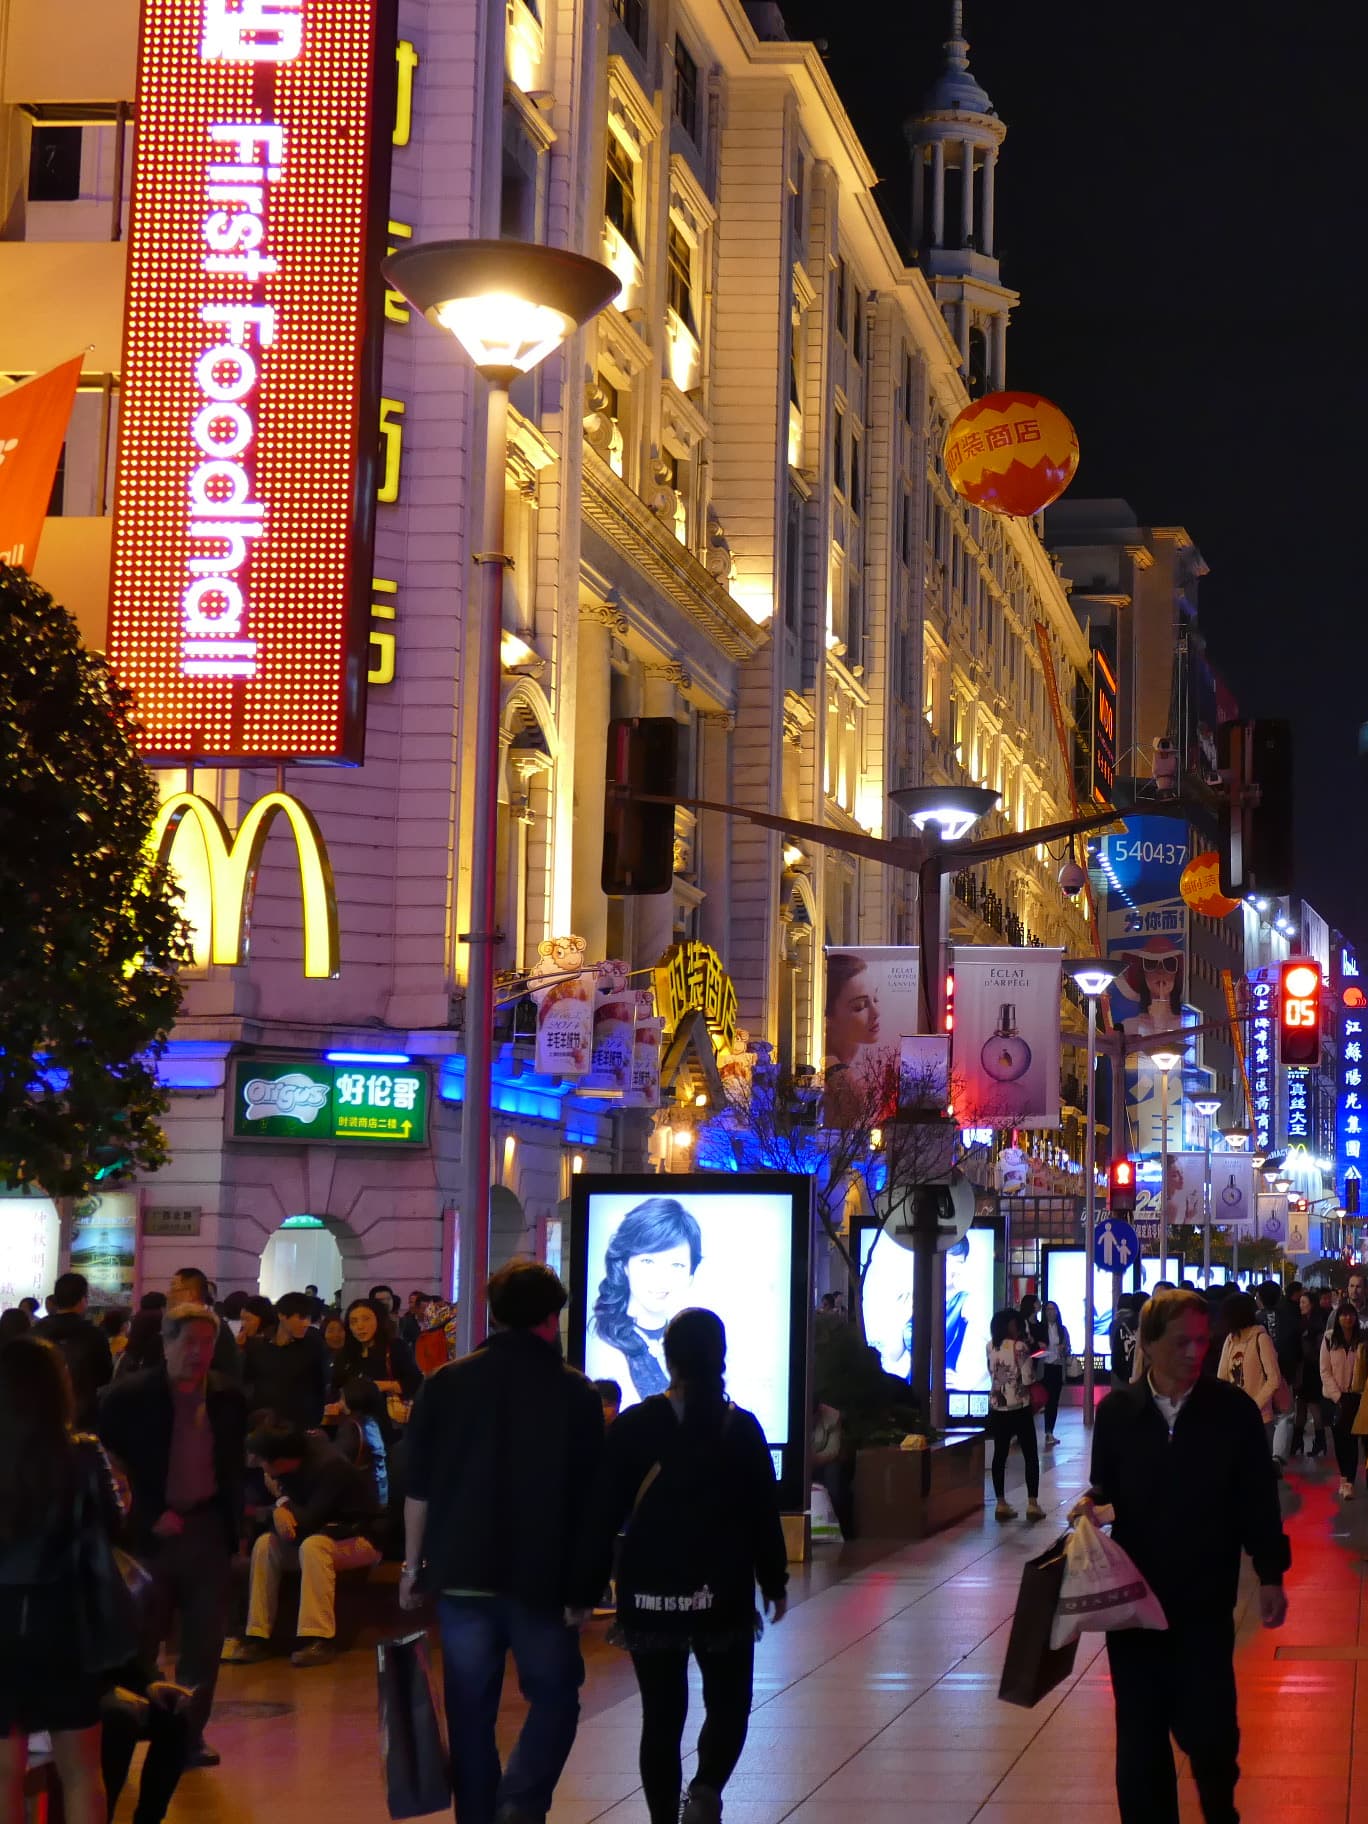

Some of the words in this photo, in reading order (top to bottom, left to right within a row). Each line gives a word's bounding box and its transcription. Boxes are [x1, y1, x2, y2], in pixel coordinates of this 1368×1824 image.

[203, 124, 283, 281] First
[182, 304, 275, 676] Foodhall
[1115, 840, 1187, 865] 540437
[1286, 1000, 1315, 1026] 05
[336, 1073, 420, 1110] 好伦哥
[634, 1593, 662, 1611] TIME
[664, 1596, 677, 1611] IS
